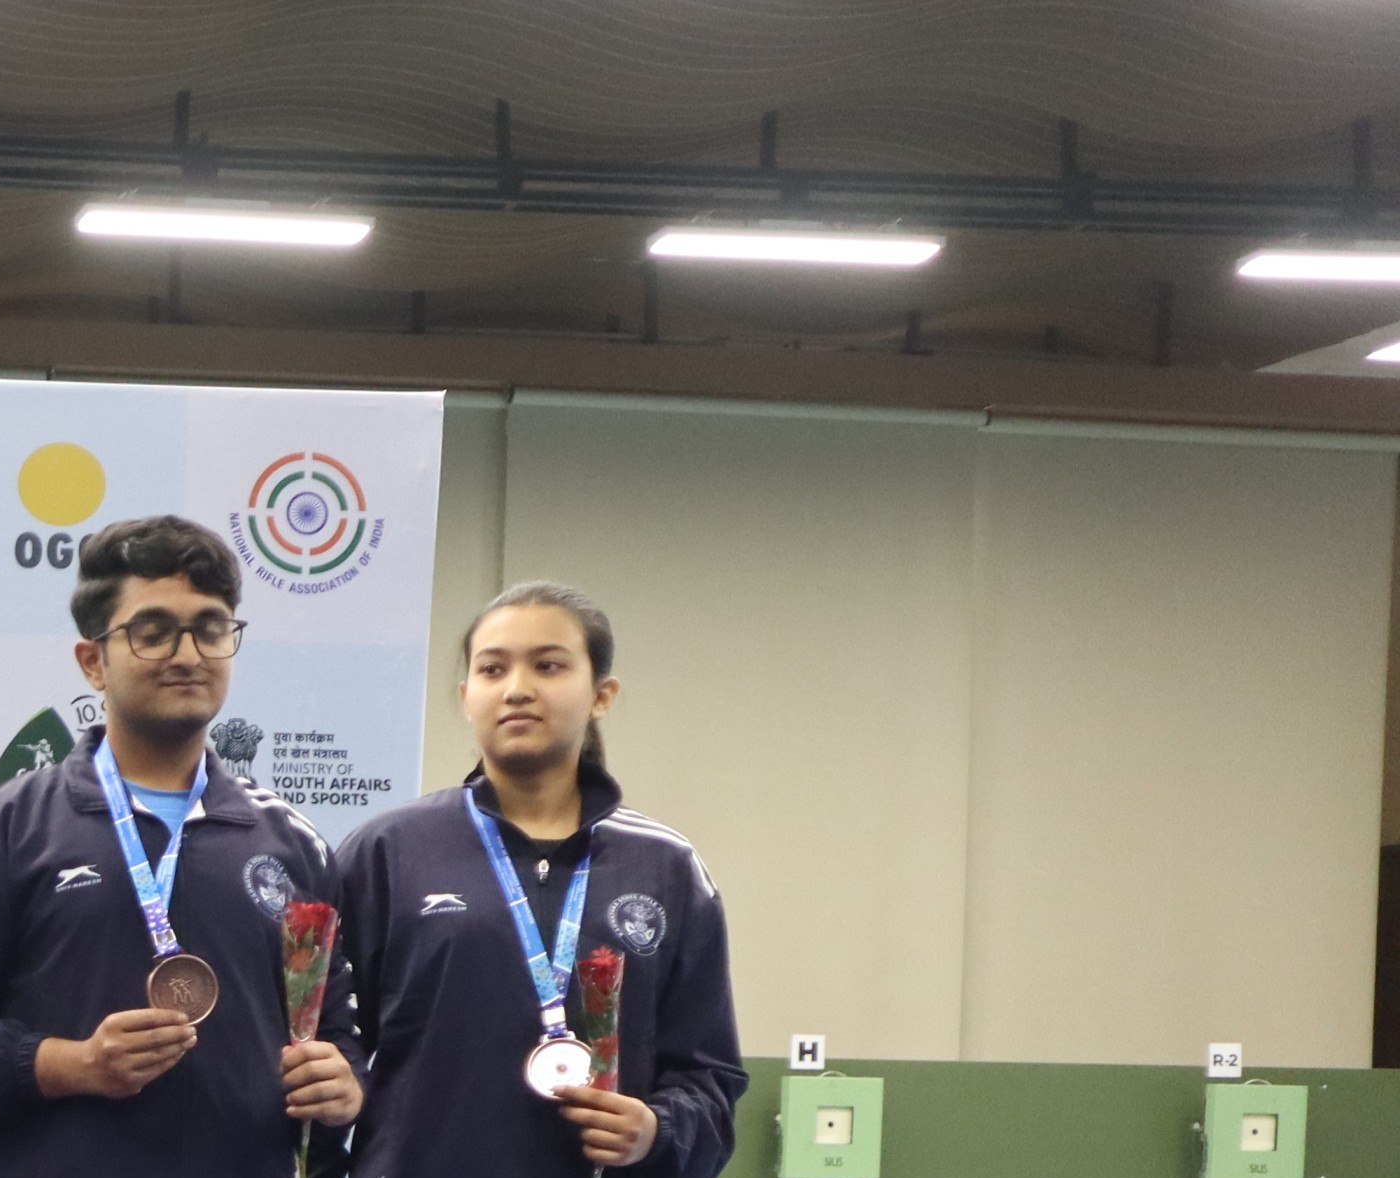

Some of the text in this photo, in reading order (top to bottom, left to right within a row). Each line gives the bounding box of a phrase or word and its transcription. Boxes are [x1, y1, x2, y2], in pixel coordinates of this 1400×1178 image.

[230, 512, 385, 595] NATIONAL RIFLE ASSOCIATION OF INDIA
[273, 762, 354, 775] MINISTRY OF
[273, 776, 391, 791] YOUTH AFFAIRS
[311, 793, 368, 805] SPORTS
[799, 1043, 819, 1062] H
[1213, 1054, 1238, 1067] R-2
